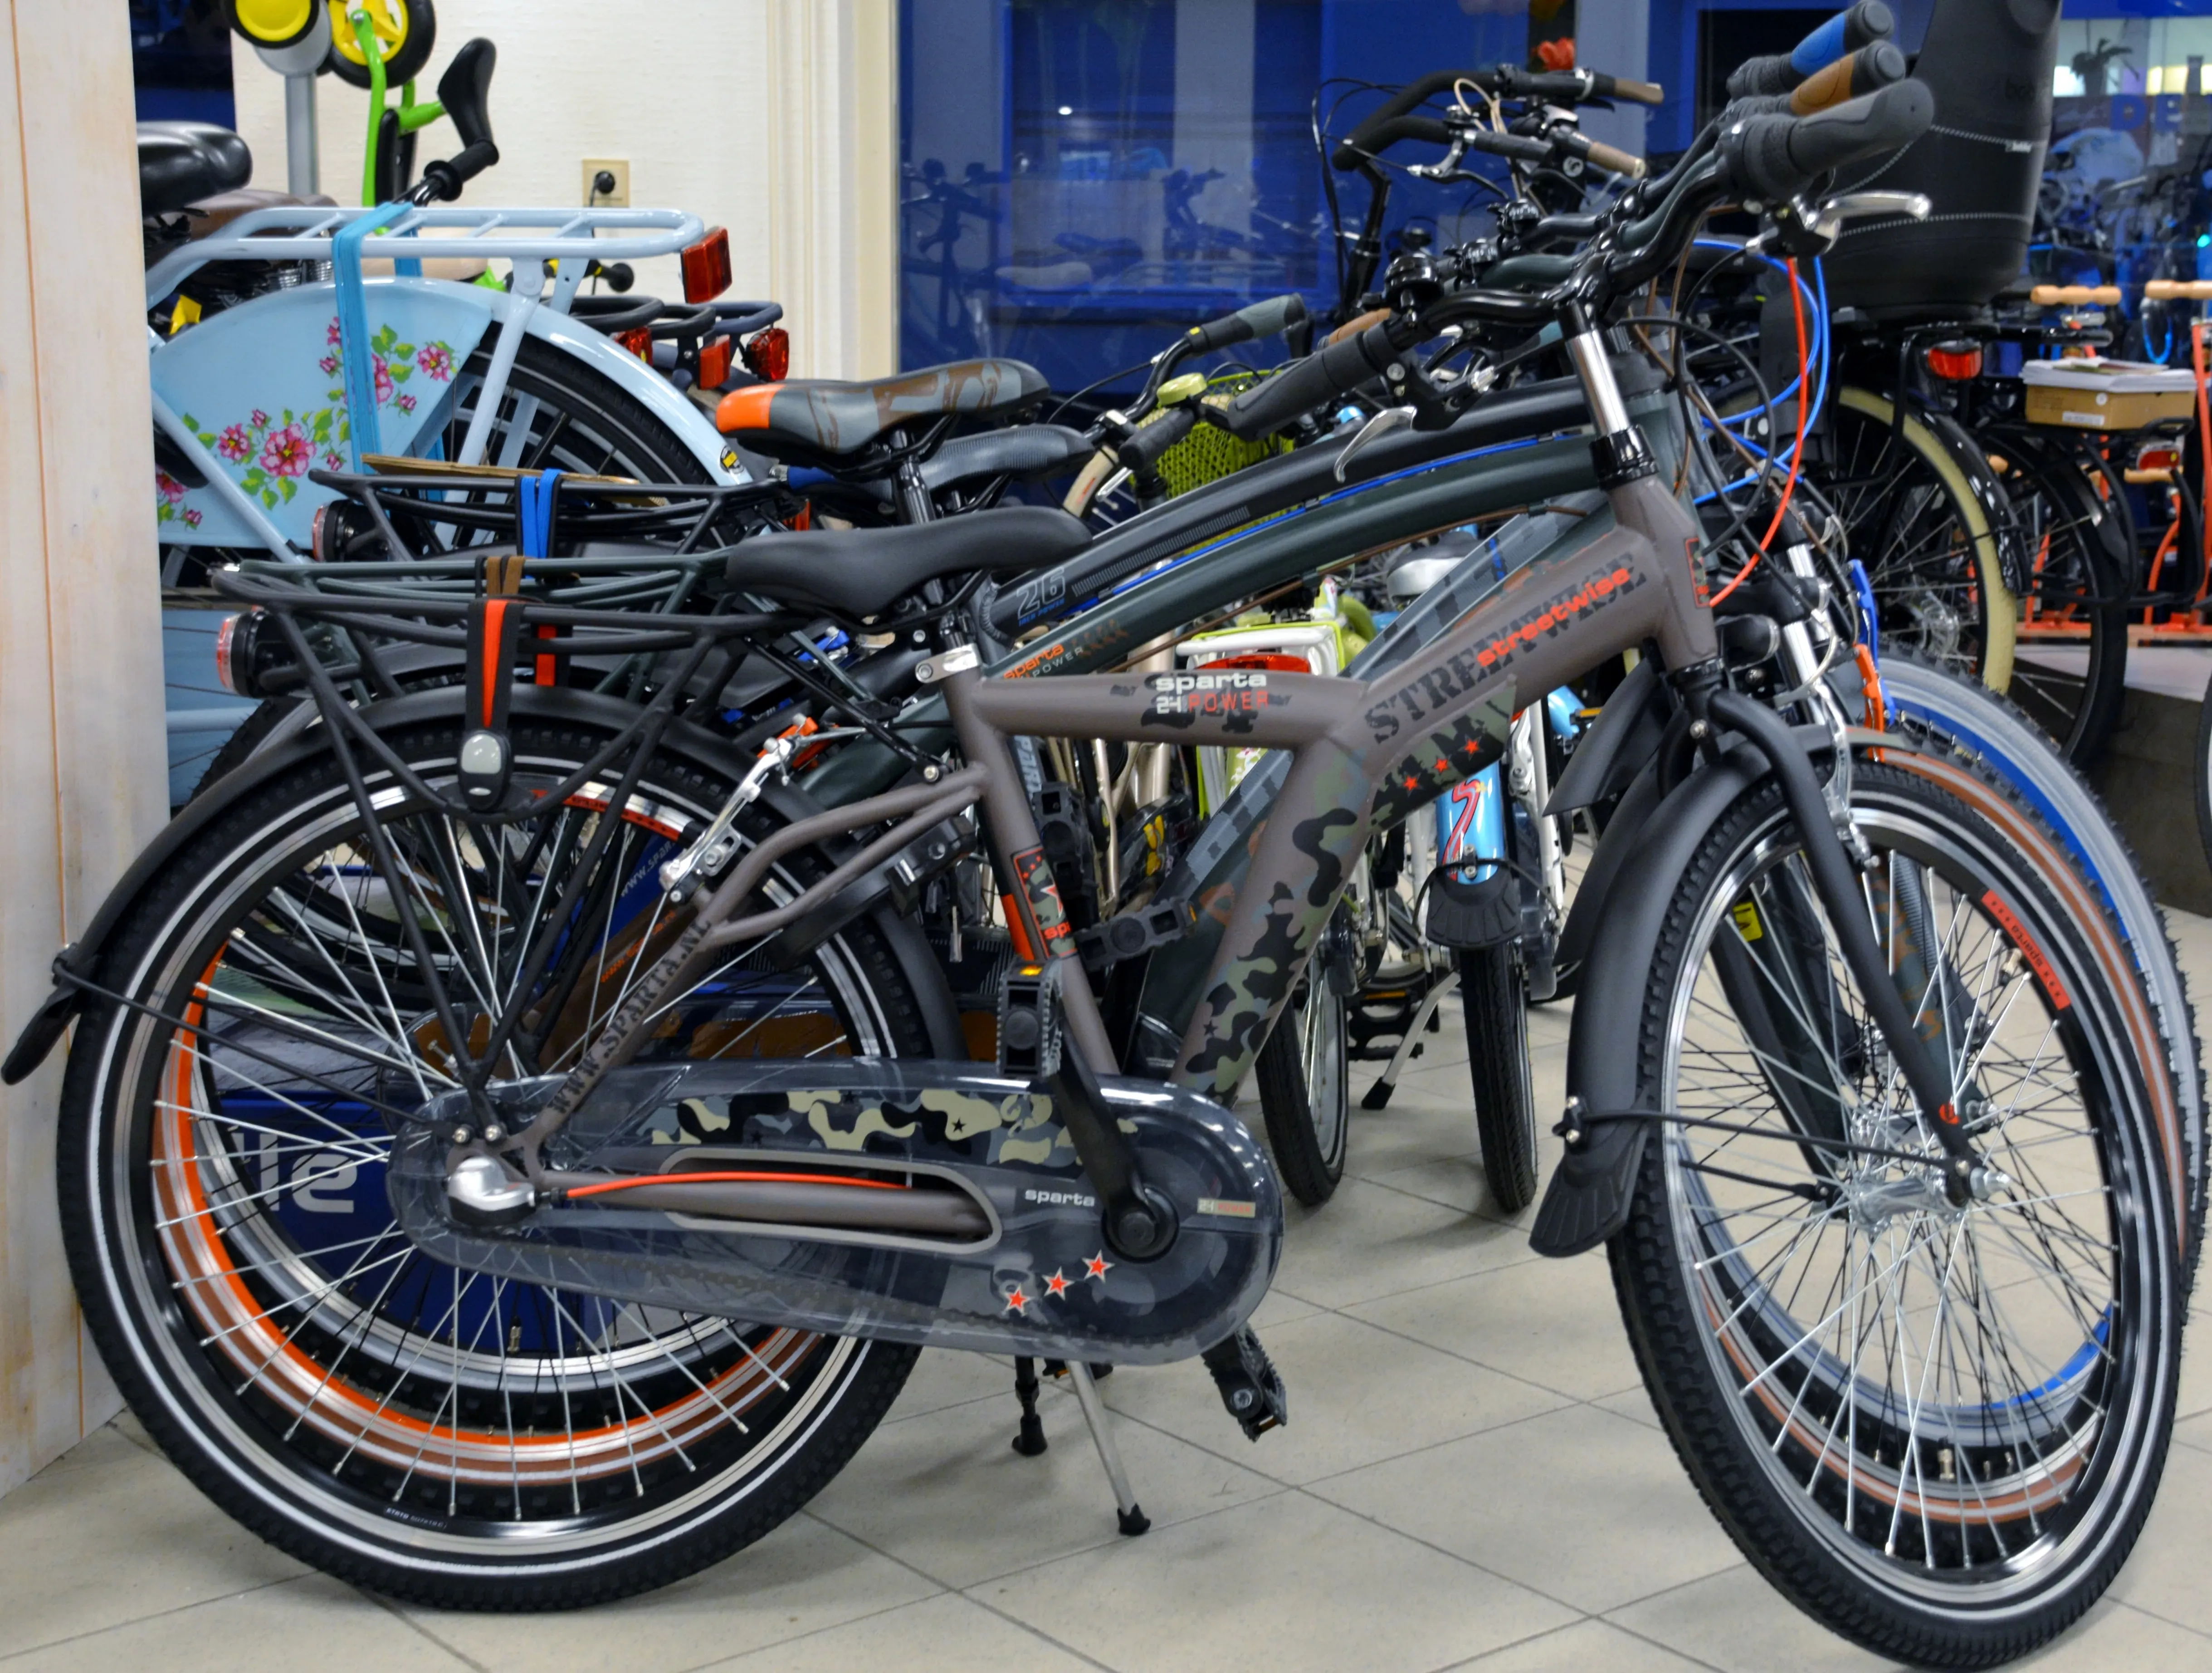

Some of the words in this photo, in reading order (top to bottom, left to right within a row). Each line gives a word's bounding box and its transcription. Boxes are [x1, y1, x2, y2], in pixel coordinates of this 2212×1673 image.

[1016, 567, 1066, 619] 26
[1476, 567, 1631, 667] streetwise
[1003, 643, 1064, 679] sparta
[1032, 646, 1084, 678] POWER
[1156, 672, 1267, 695] sparta
[1156, 696, 1182, 714] 24
[1188, 690, 1270, 712] POWER
[1044, 921, 1072, 939] sp
[2011, 924, 2044, 968] sparta
[1025, 1189, 1095, 1208] sparta
